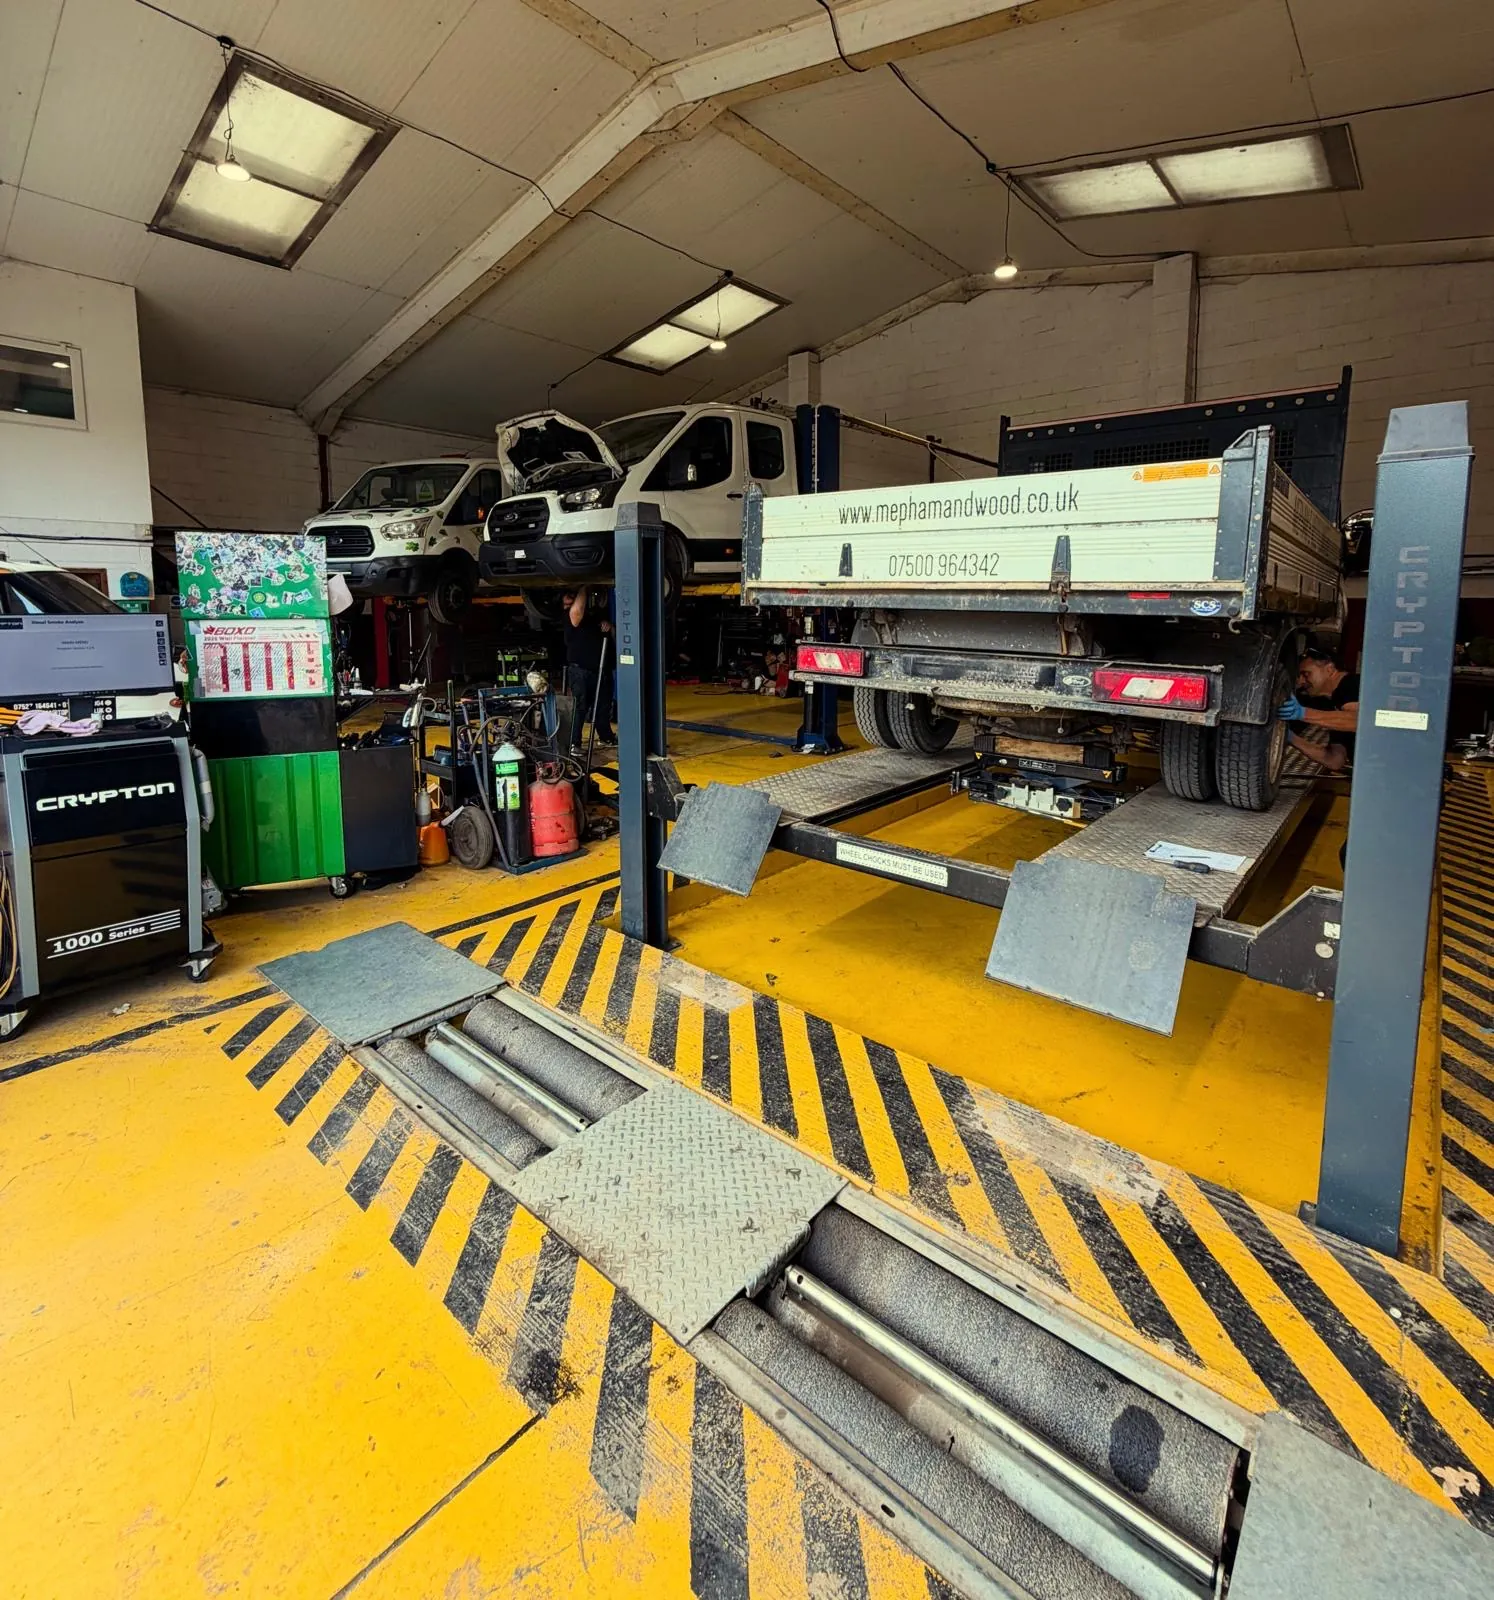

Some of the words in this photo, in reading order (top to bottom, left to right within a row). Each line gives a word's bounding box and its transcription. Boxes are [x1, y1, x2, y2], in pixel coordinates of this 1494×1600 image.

[838, 483, 1080, 525] www.mephamandwood.co.uk
[888, 554, 933, 578] 07500
[938, 552, 1000, 577] 964342
[1193, 600, 1217, 610] SCS
[214, 626, 256, 635] BOXO
[1388, 545, 1431, 712] CRYPTON
[36, 782, 175, 812] CRYPTON
[840, 847, 862, 860] WHEEL
[863, 853, 892, 867] CHOCKS
[892, 860, 911, 872] MUST
[912, 866, 923, 875] BE
[924, 869, 945, 881] USED
[53, 932, 103, 953] 1000
[108, 925, 145, 940] Series
